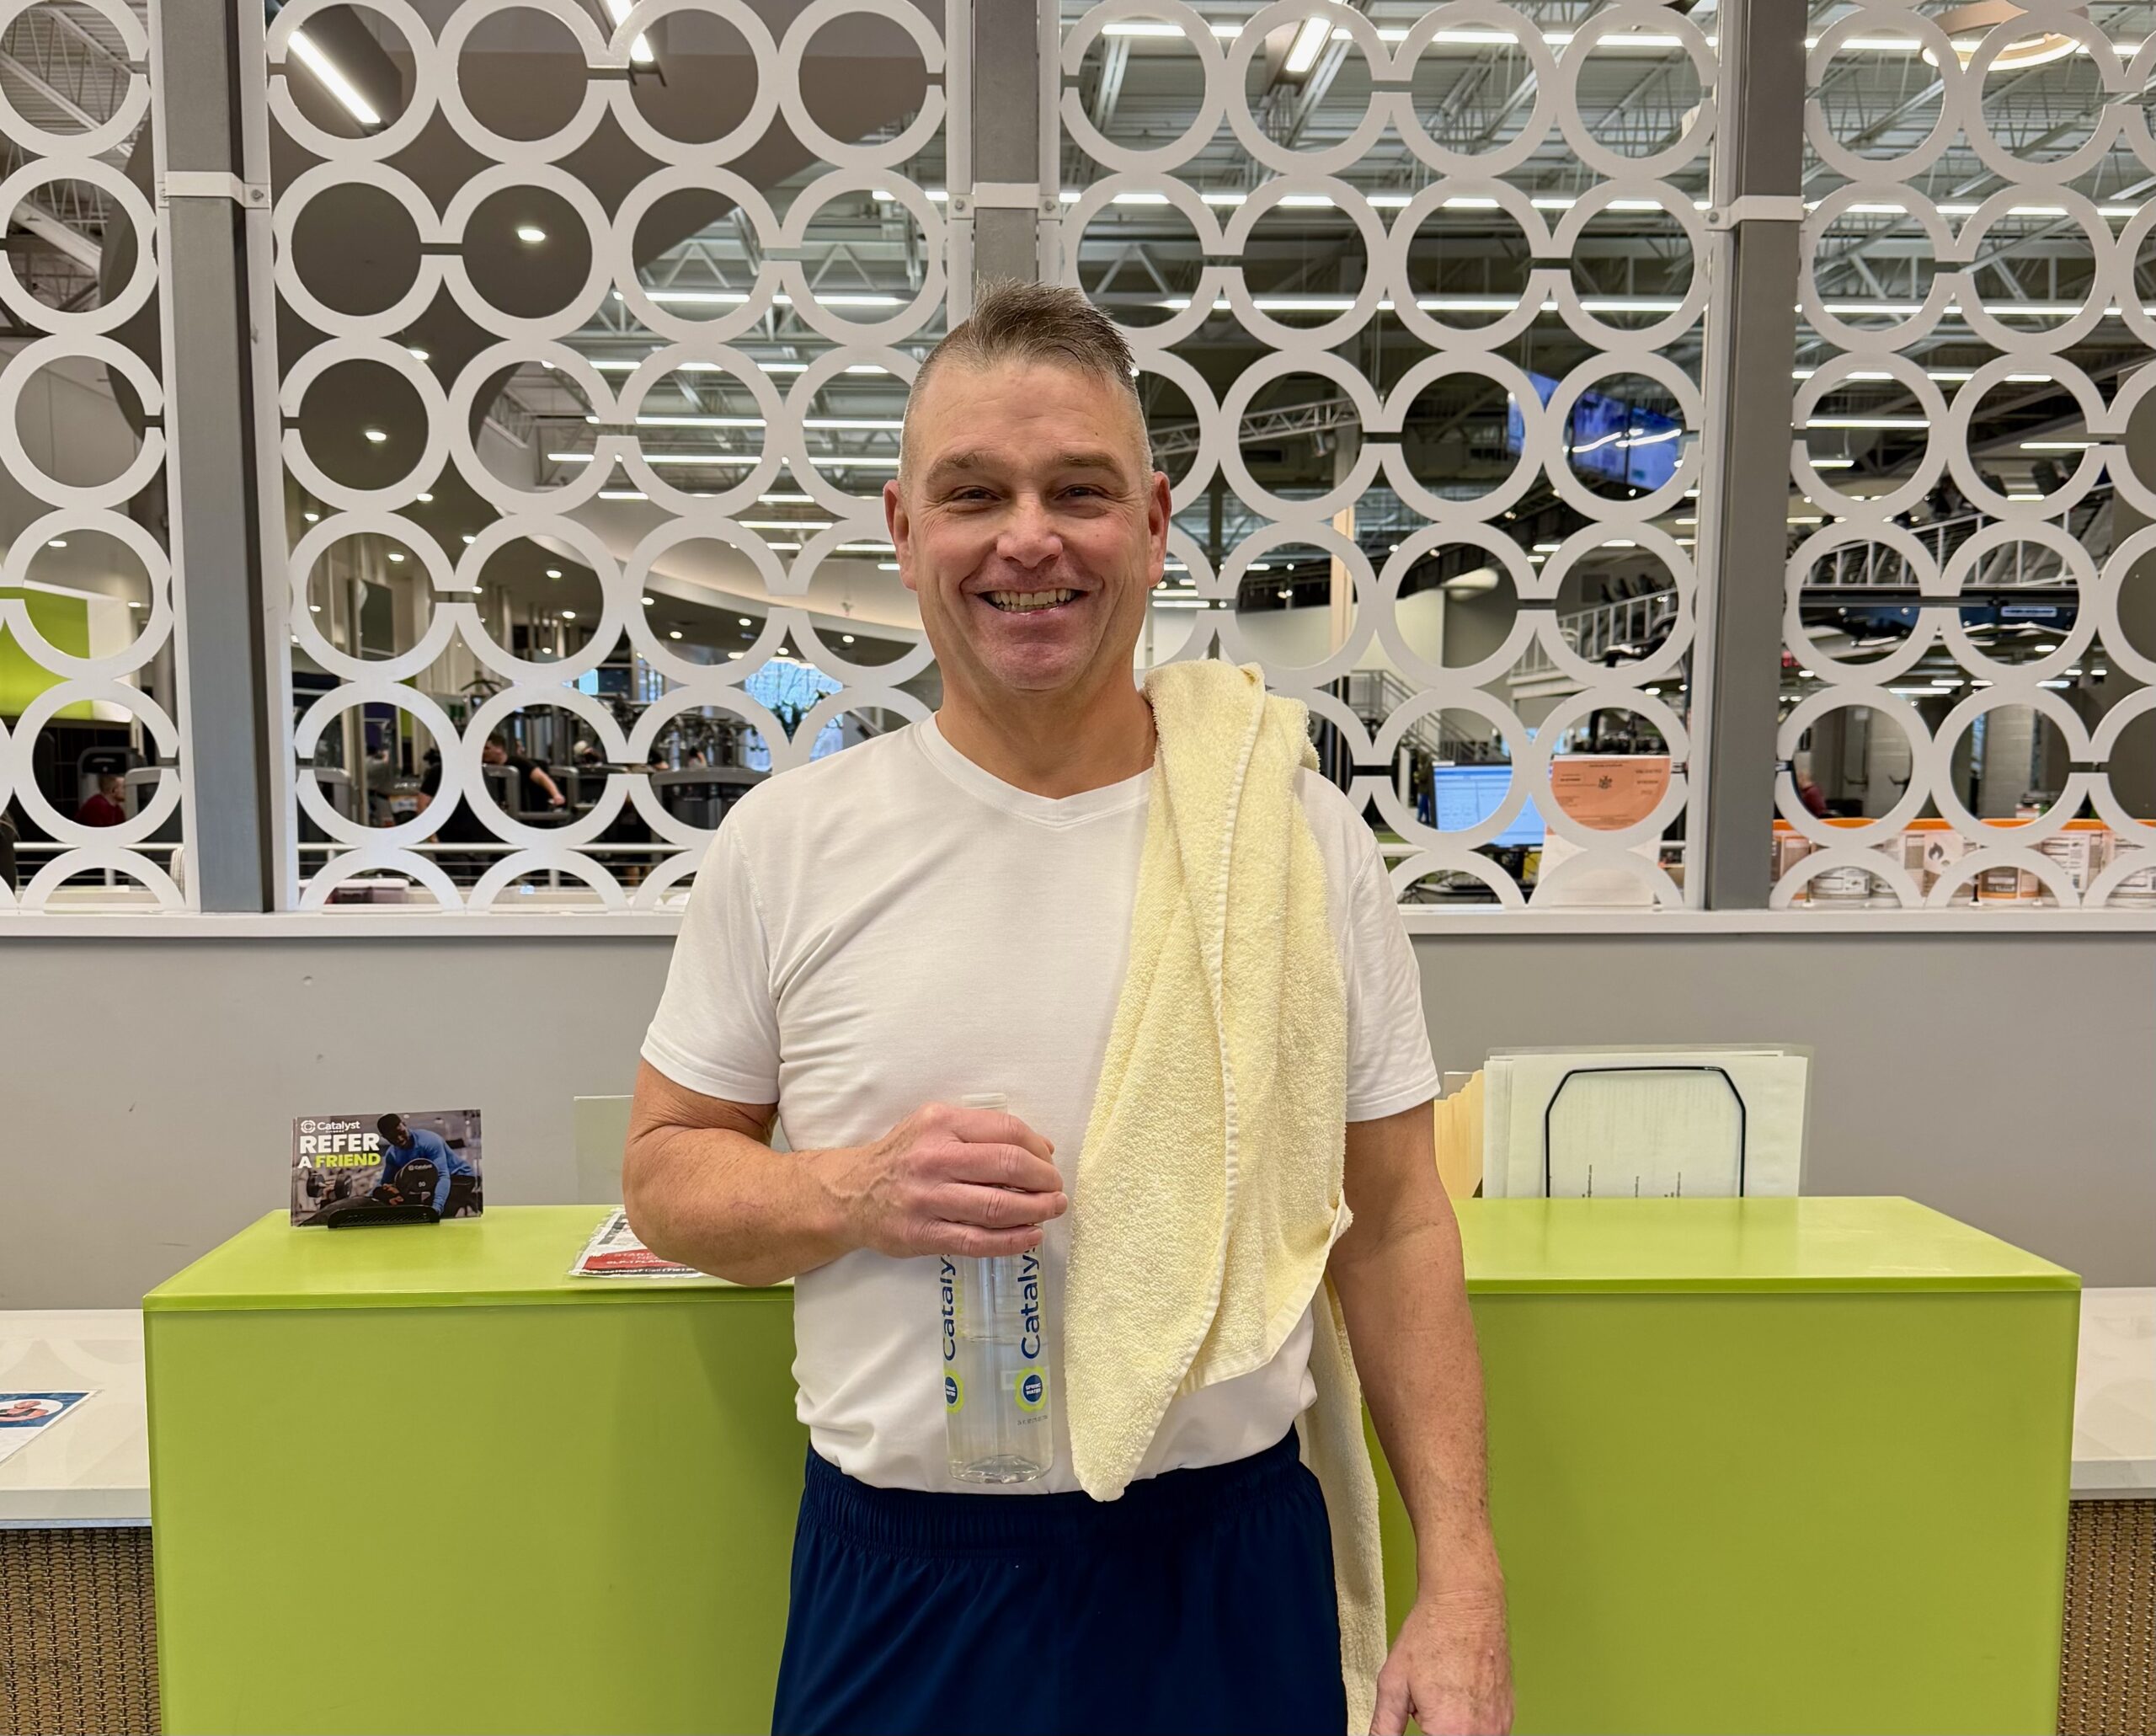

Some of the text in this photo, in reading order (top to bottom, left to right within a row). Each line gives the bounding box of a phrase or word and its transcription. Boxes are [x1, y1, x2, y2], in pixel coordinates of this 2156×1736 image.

[317, 1121, 360, 1130] Catalyst
[300, 1133, 380, 1154] REFER
[297, 1153, 382, 1168] A FRIEND
[940, 1253, 956, 1361] Cataly
